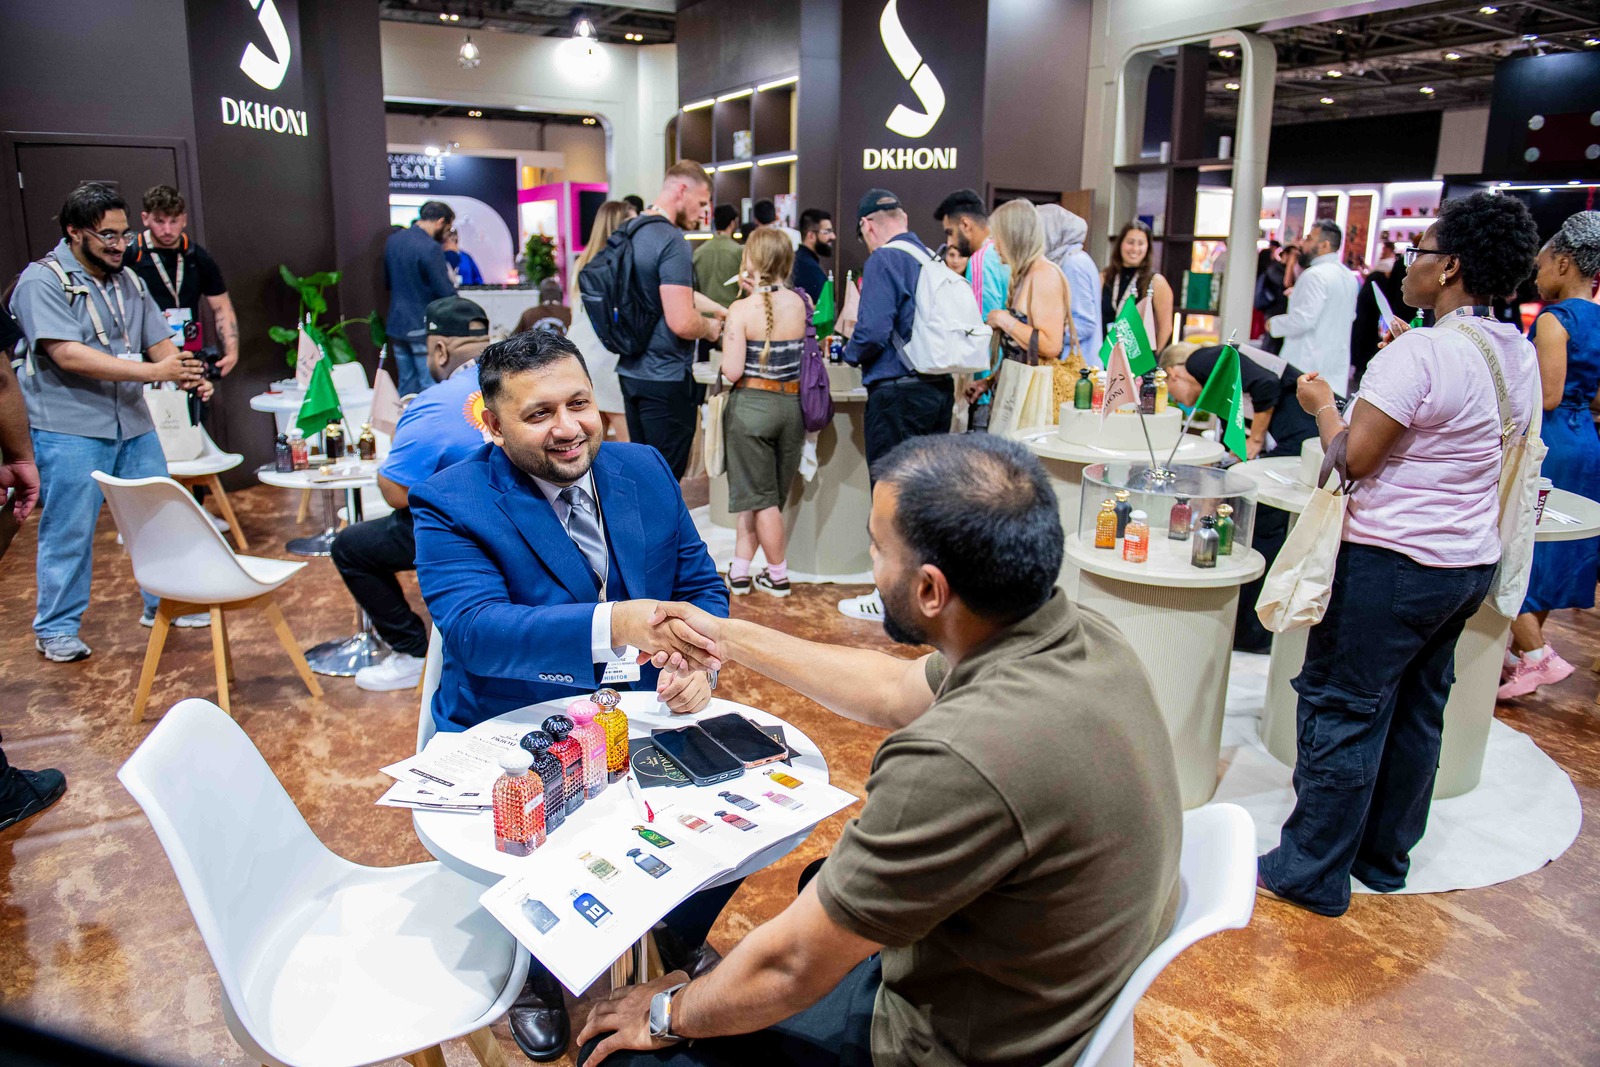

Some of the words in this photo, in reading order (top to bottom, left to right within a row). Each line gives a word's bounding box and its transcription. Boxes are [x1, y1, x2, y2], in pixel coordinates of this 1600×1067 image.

[221, 96, 308, 137] DKHONI
[863, 147, 957, 170] DKHONI
[1457, 323, 1496, 370] MICHAEL
[1494, 371, 1508, 402] KORS
[585, 903, 605, 920] 10
